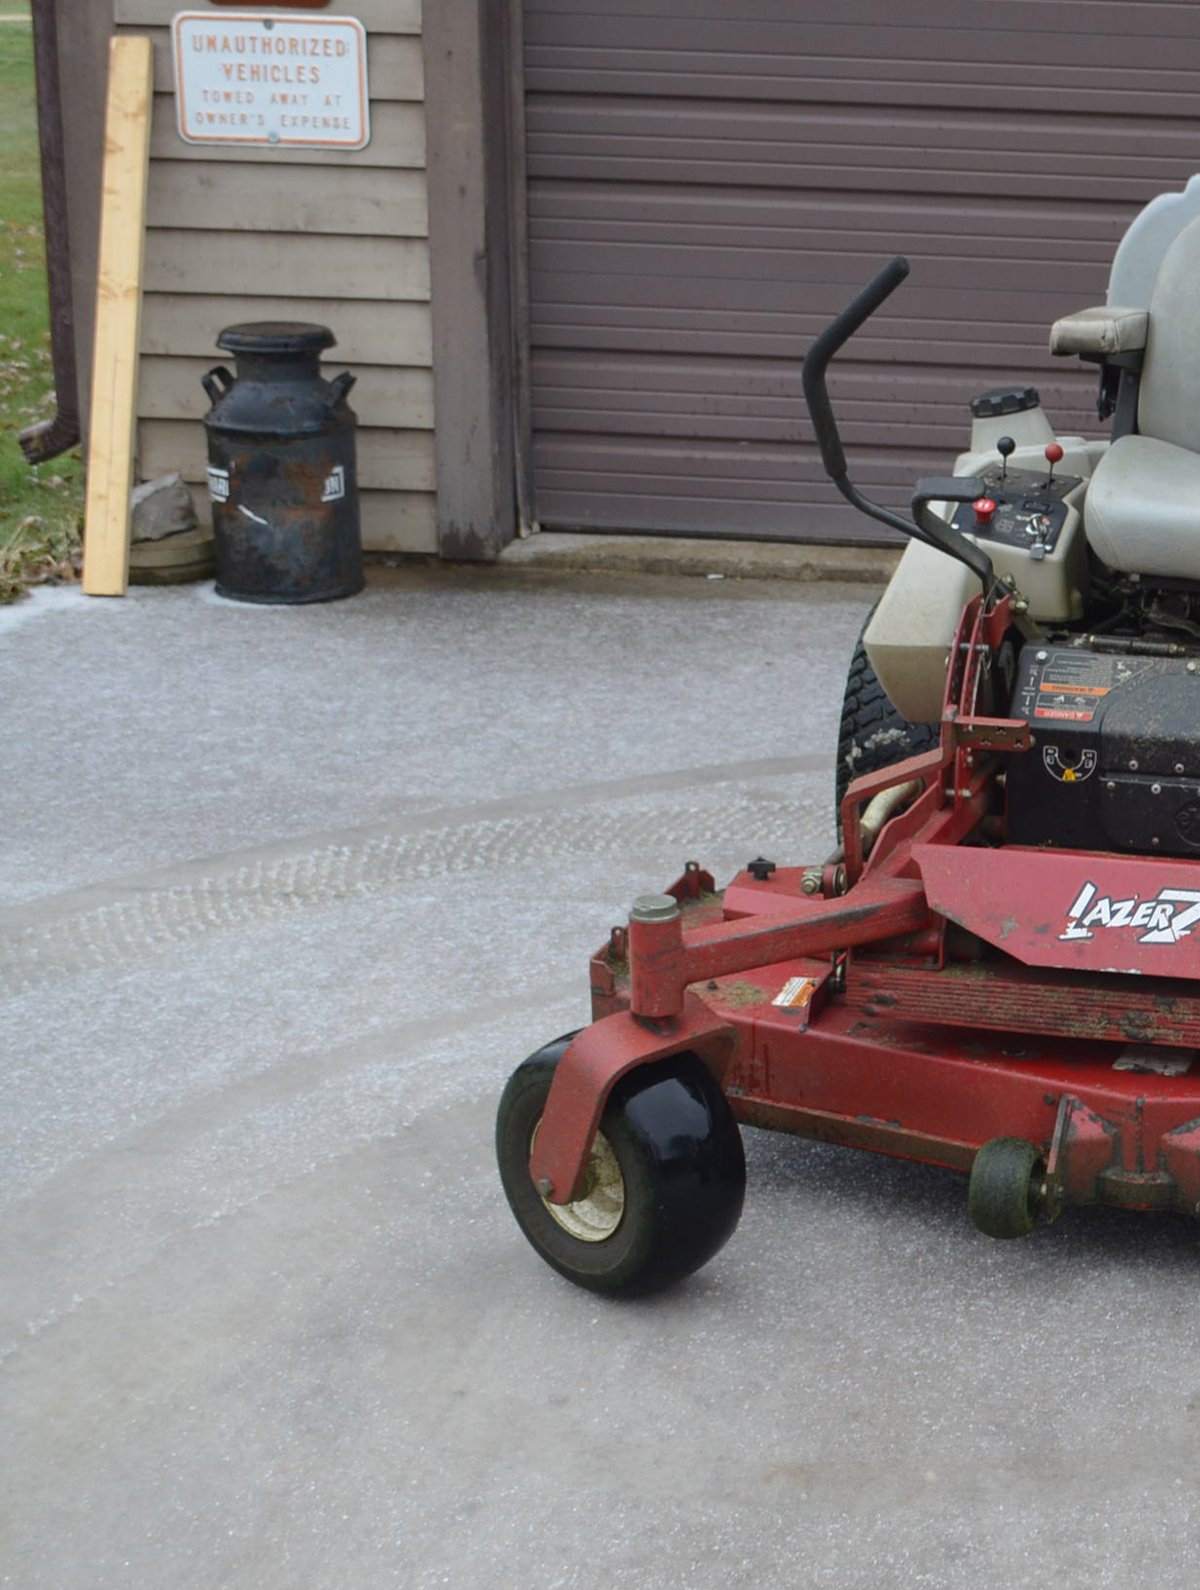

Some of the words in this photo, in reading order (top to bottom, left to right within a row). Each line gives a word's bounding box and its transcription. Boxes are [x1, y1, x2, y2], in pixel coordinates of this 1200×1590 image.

[192, 34, 347, 57] UNAUTHORIZED
[221, 63, 320, 83] VEHICLES
[202, 89, 254, 104] TOWED
[270, 92, 308, 106] AWAY
[324, 94, 343, 107] AT
[195, 112, 265, 126] OWNER'S
[280, 114, 351, 130] EXPENSE
[1058, 880, 1175, 940] LAZER
